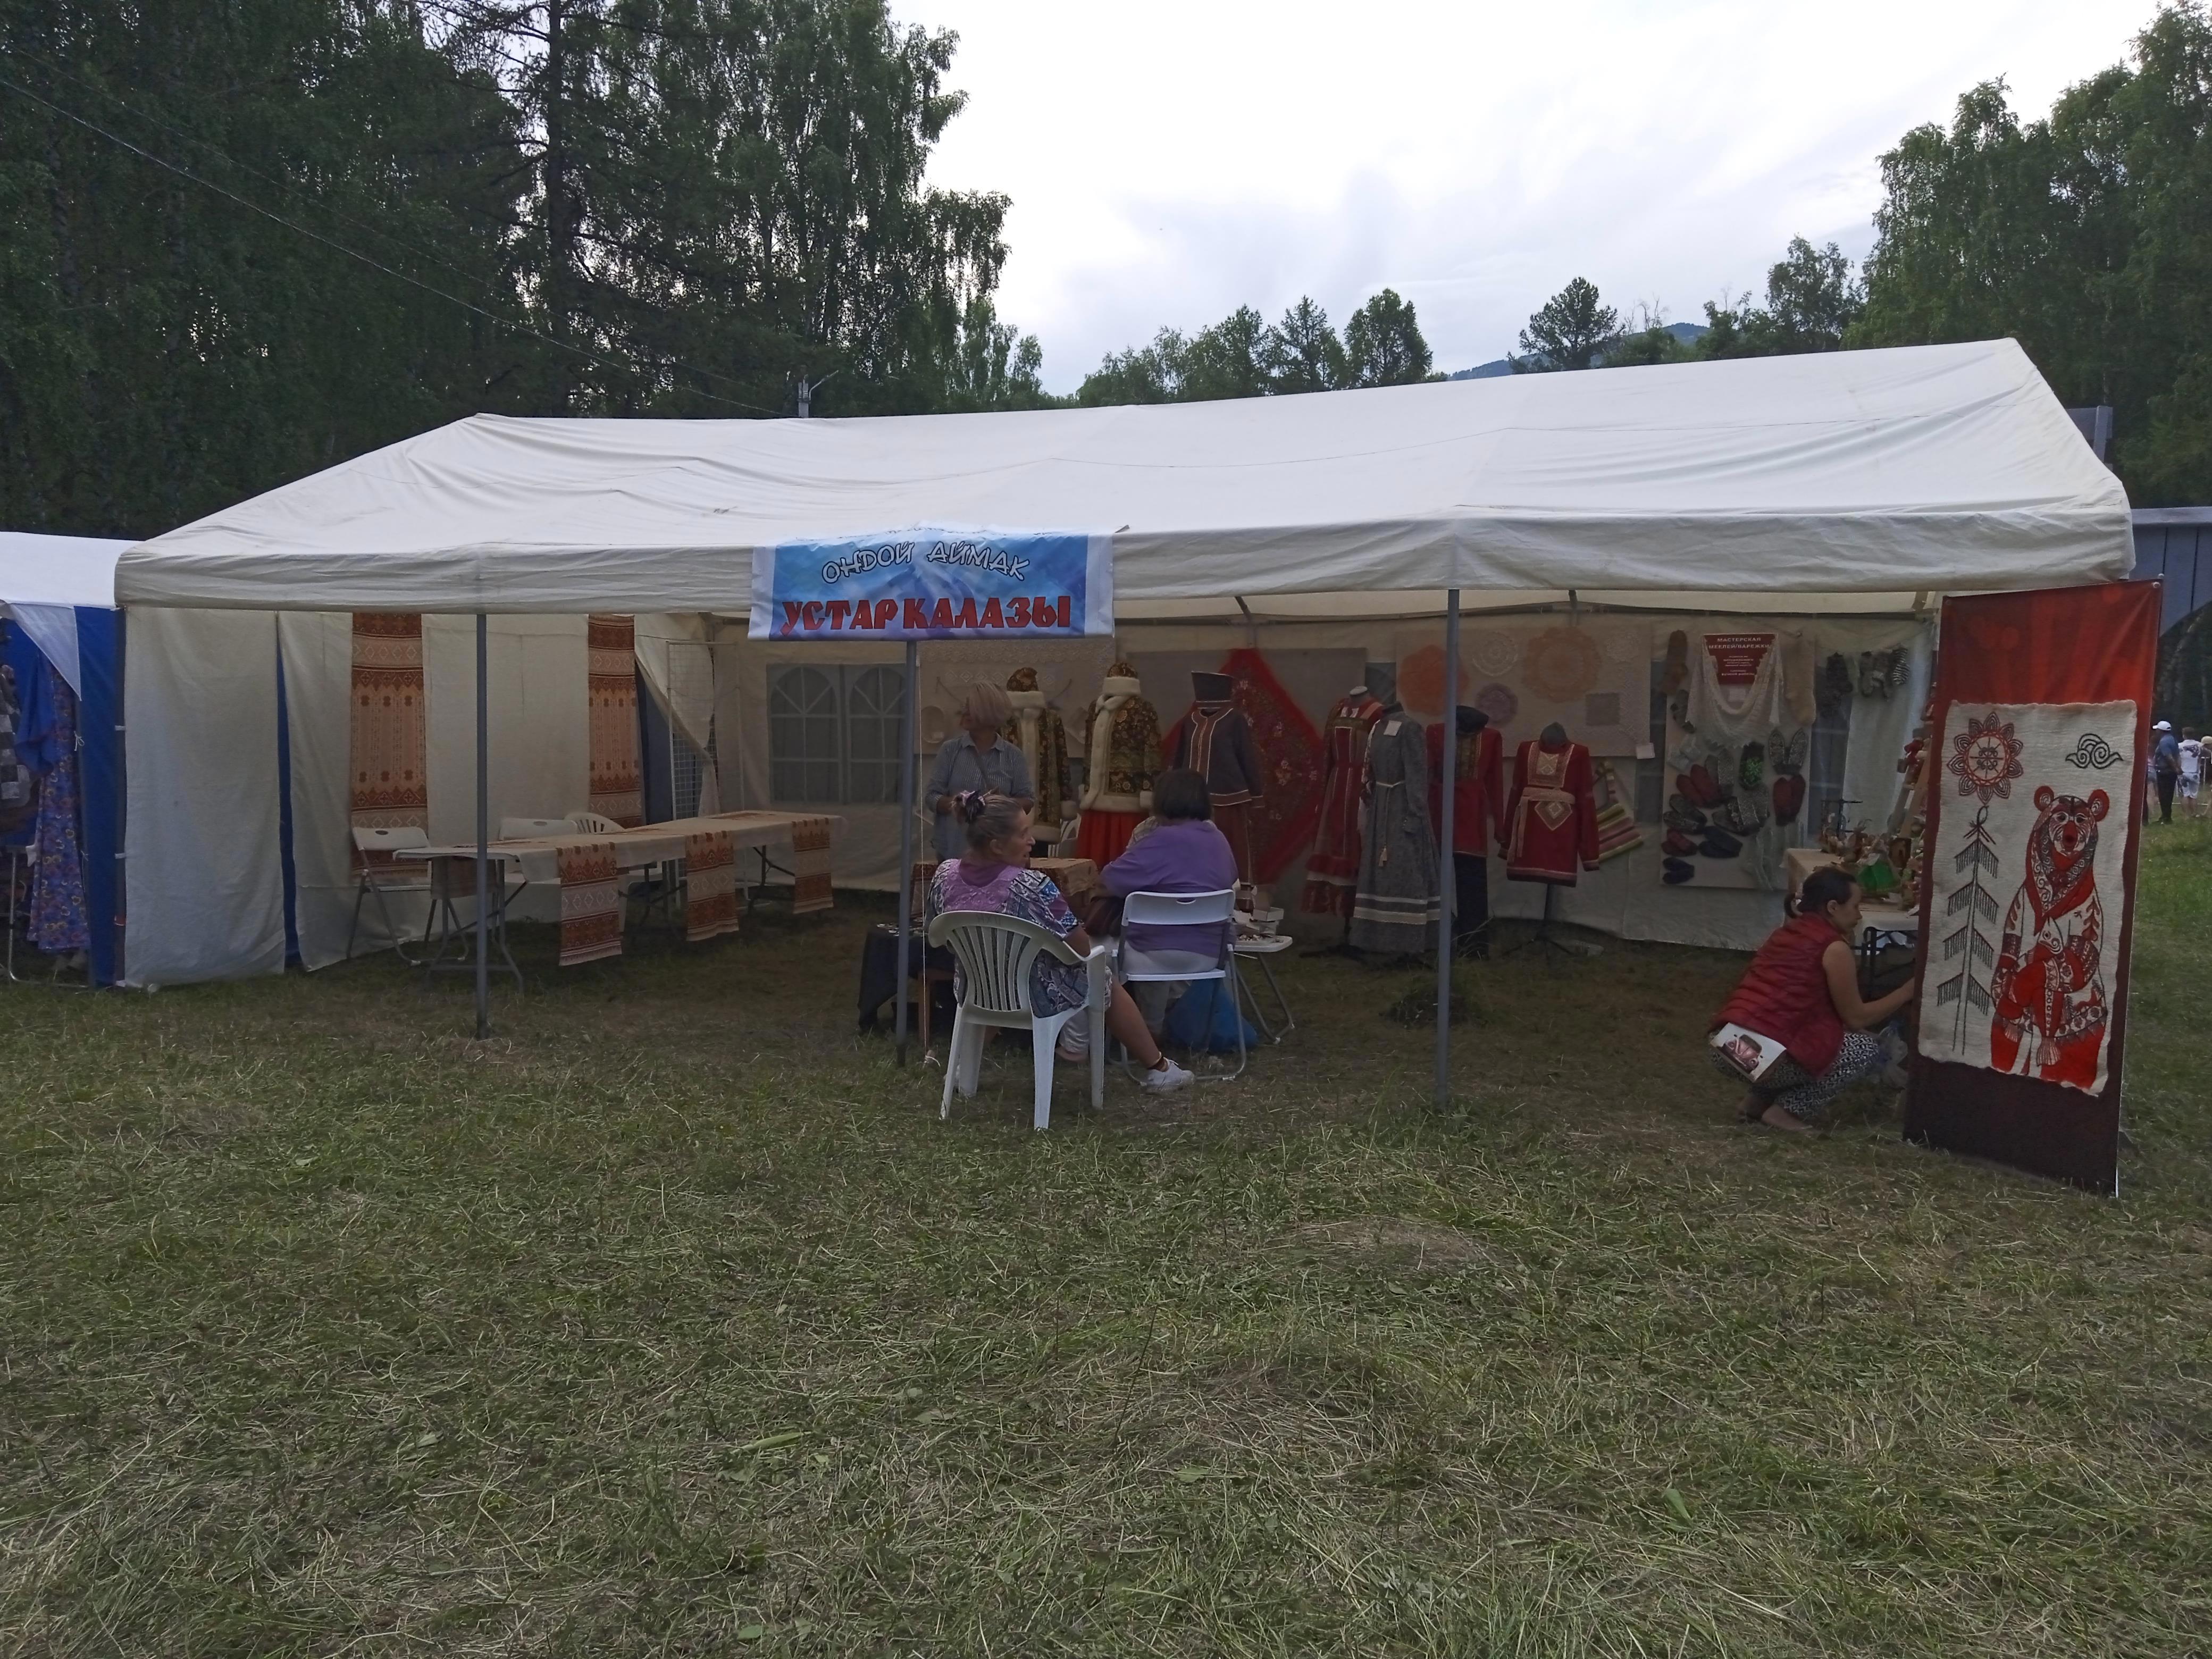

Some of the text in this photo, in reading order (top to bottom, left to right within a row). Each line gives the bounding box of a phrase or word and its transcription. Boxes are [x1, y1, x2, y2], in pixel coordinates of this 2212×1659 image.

[926, 540, 1030, 581] АЙМАК
[780, 596, 1070, 637] УСТАР КАЛАЗЫ
